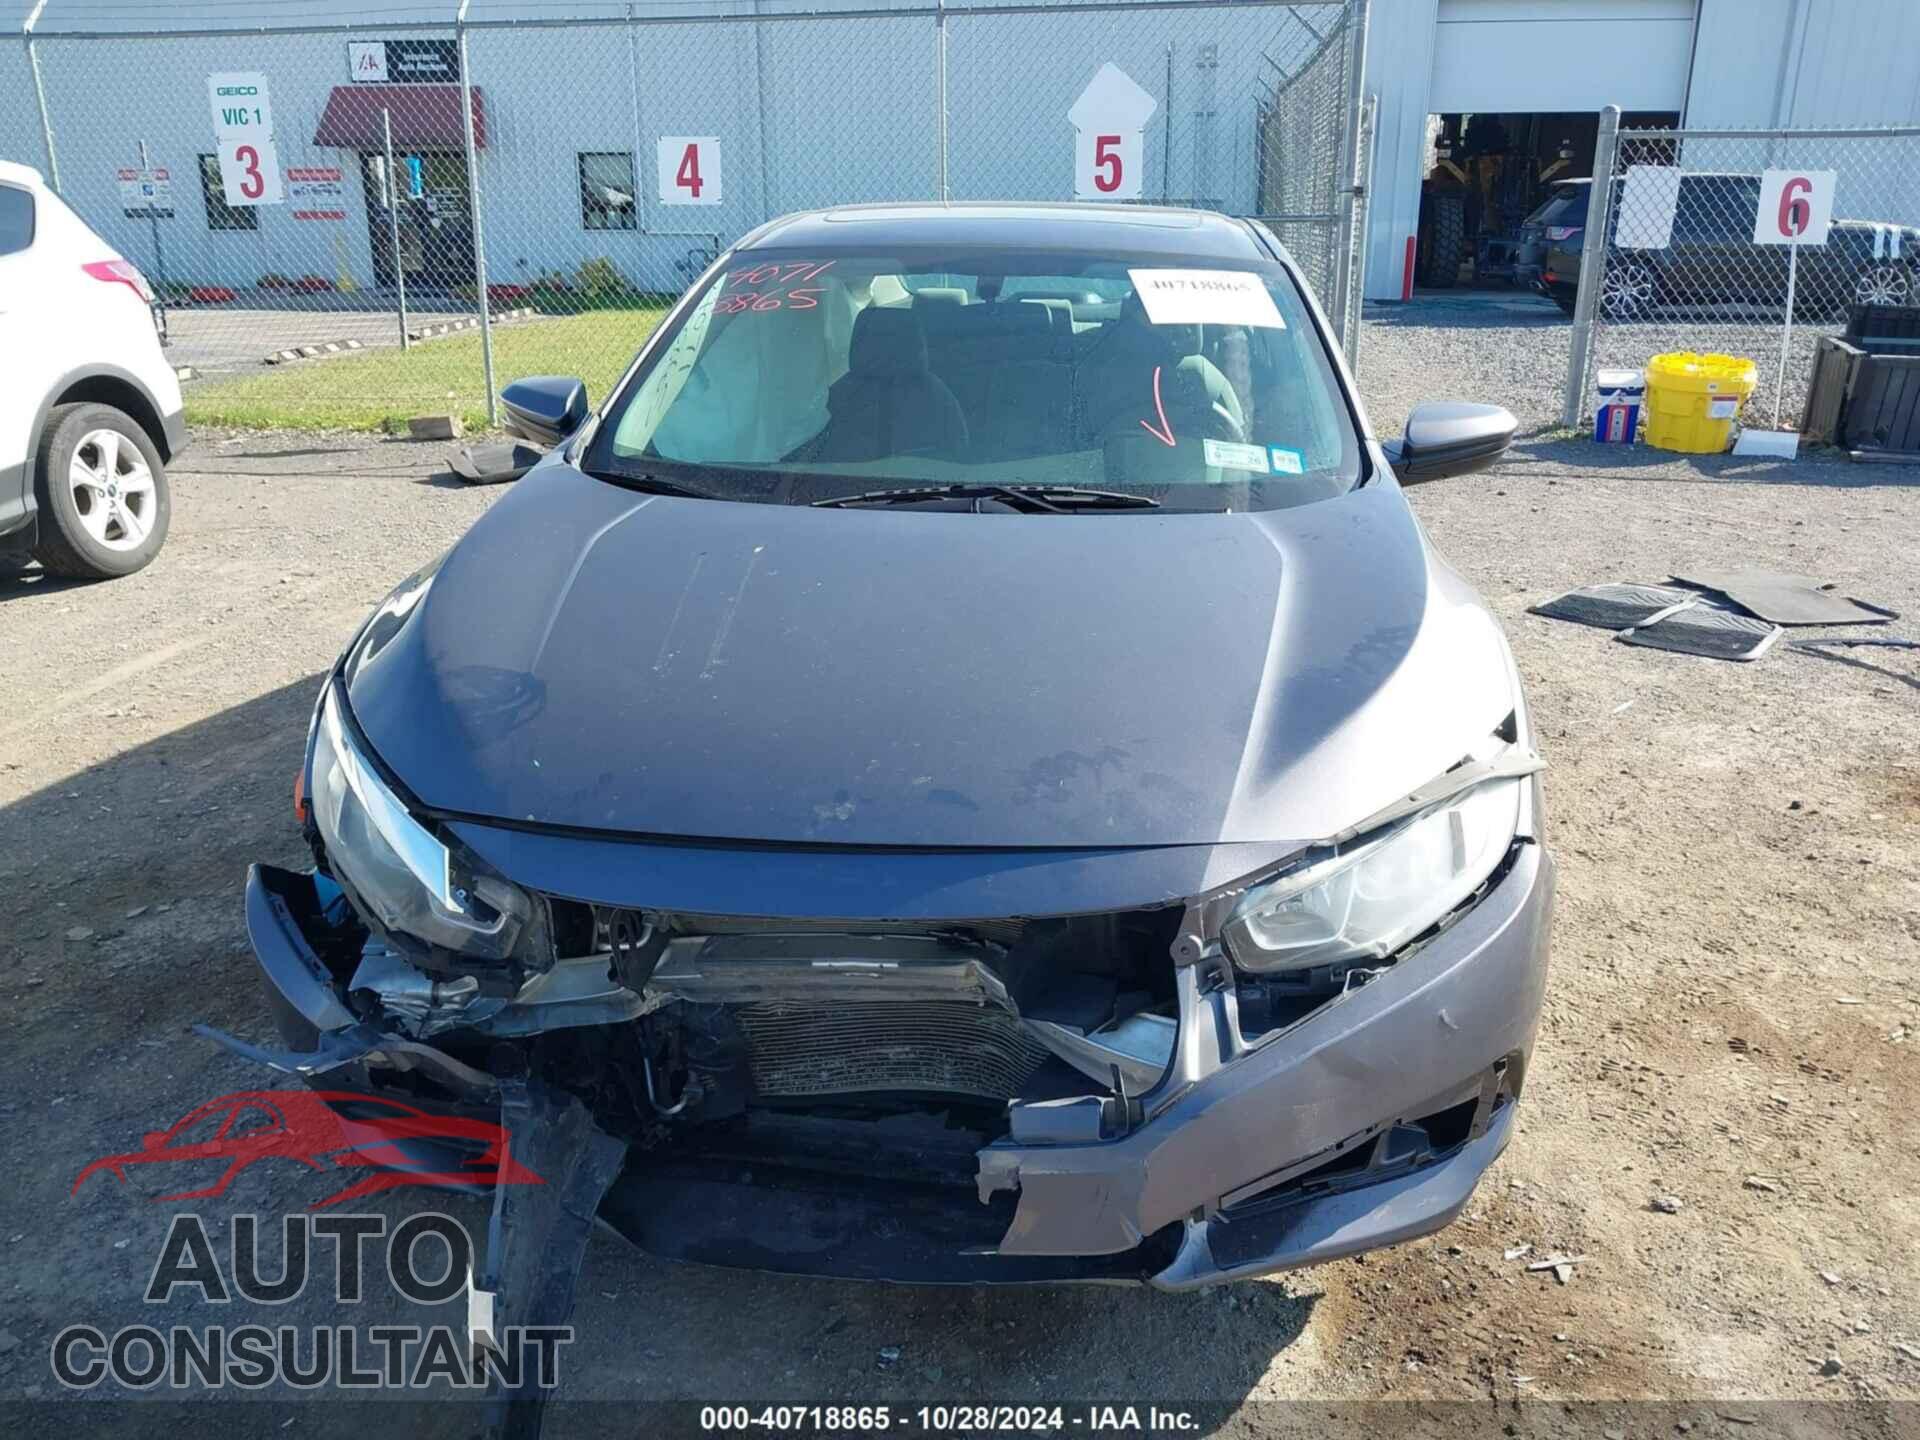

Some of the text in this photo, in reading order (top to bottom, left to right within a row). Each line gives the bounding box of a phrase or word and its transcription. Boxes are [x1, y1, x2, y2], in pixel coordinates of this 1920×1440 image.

[217, 86, 257, 96] GEICO
[222, 107, 262, 125] VIC 1
[235, 145, 264, 199] 3
[676, 143, 703, 198] 4
[1094, 135, 1122, 192] 5
[1778, 176, 1813, 237] 6
